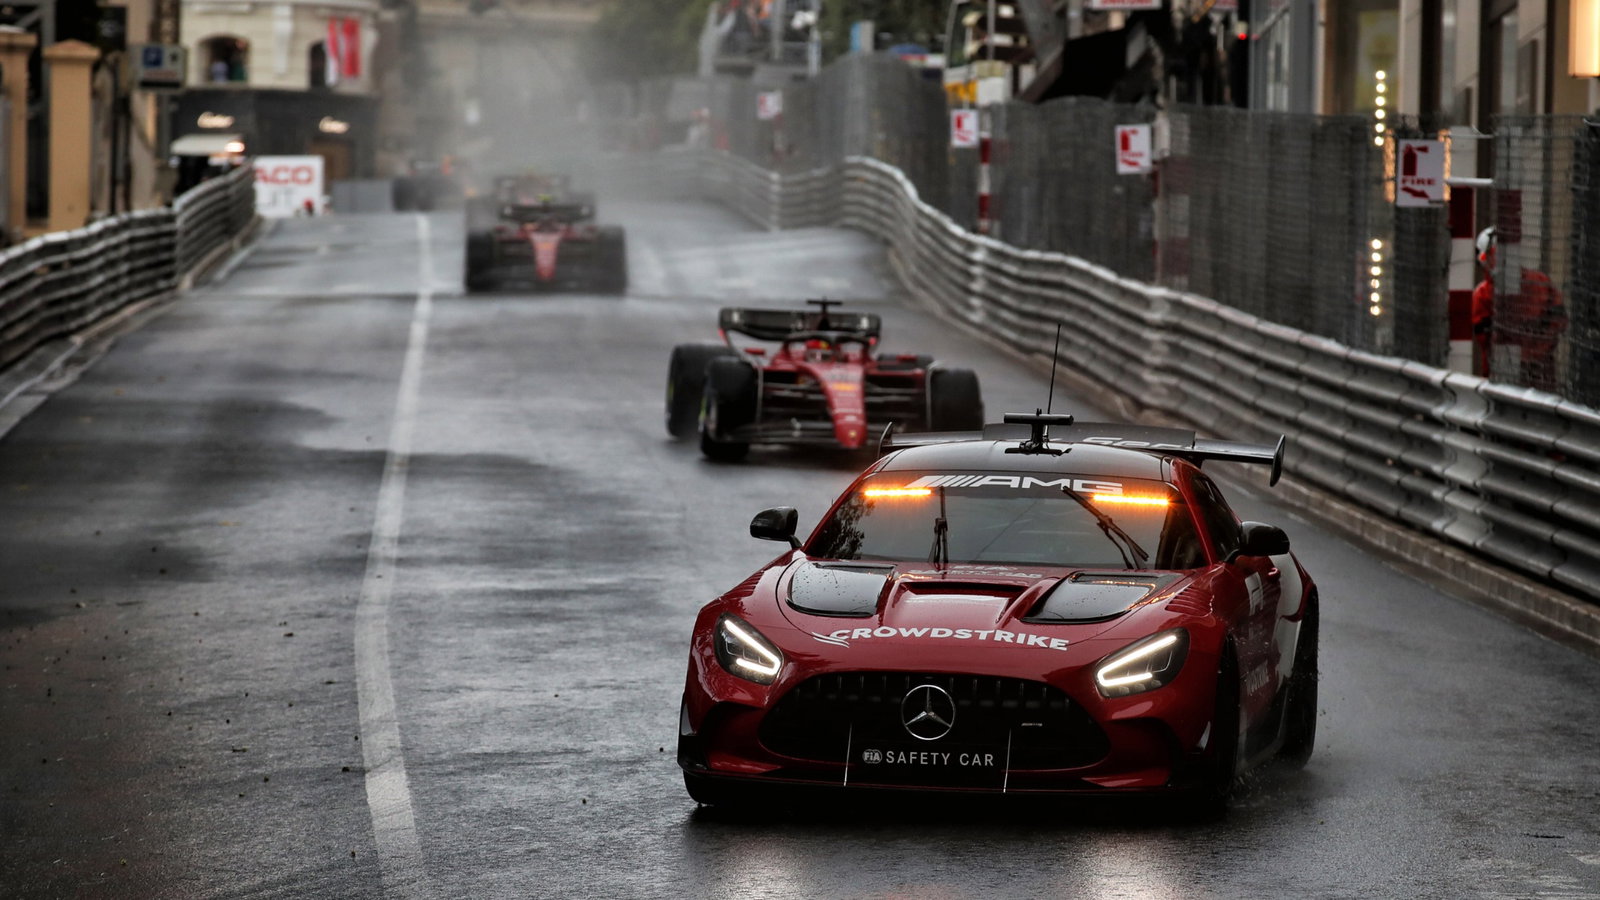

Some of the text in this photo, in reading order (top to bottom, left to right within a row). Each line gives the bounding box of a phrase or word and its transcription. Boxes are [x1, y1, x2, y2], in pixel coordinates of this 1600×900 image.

[827, 625, 1070, 652] CROWDSTRIKE
[885, 750, 951, 766] SAFETY
[959, 752, 994, 767] CAR
